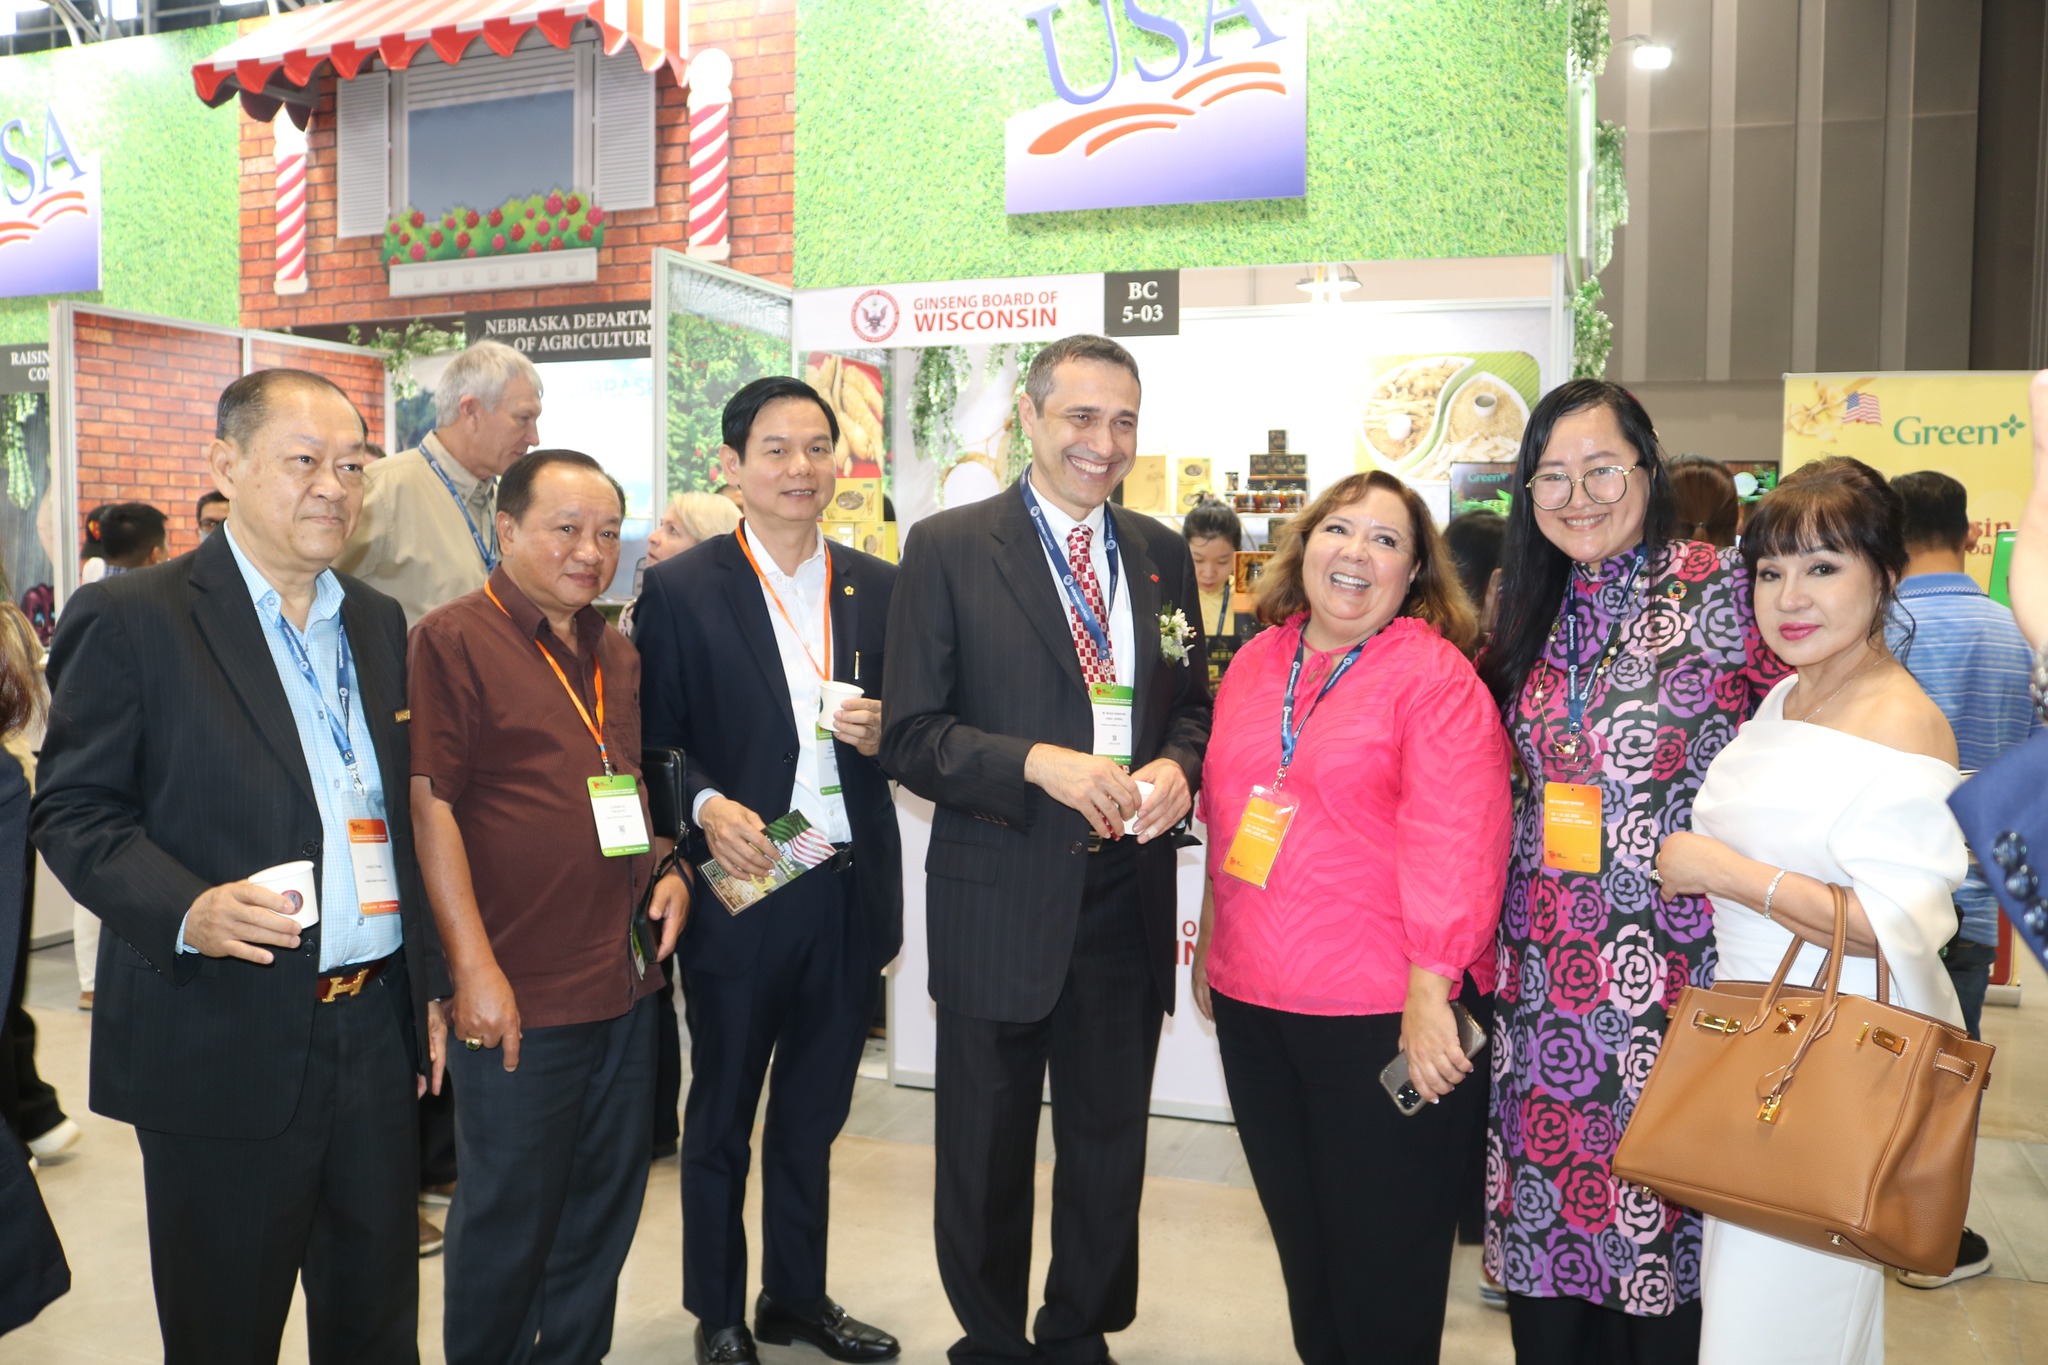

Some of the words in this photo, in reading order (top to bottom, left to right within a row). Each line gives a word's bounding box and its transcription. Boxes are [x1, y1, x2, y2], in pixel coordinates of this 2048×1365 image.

[1025, 0, 1287, 105] USA
[913, 294, 978, 311] GINSENG
[982, 292, 1034, 307] BOARD
[1038, 290, 1058, 304] OF
[1128, 281, 1158, 300] BC
[914, 307, 1057, 332] WISCONSIN
[1122, 304, 1164, 324] 5-03
[485, 314, 570, 335] NEBRASKA
[514, 336, 538, 352] OF
[11, 350, 49, 366] RAISIN
